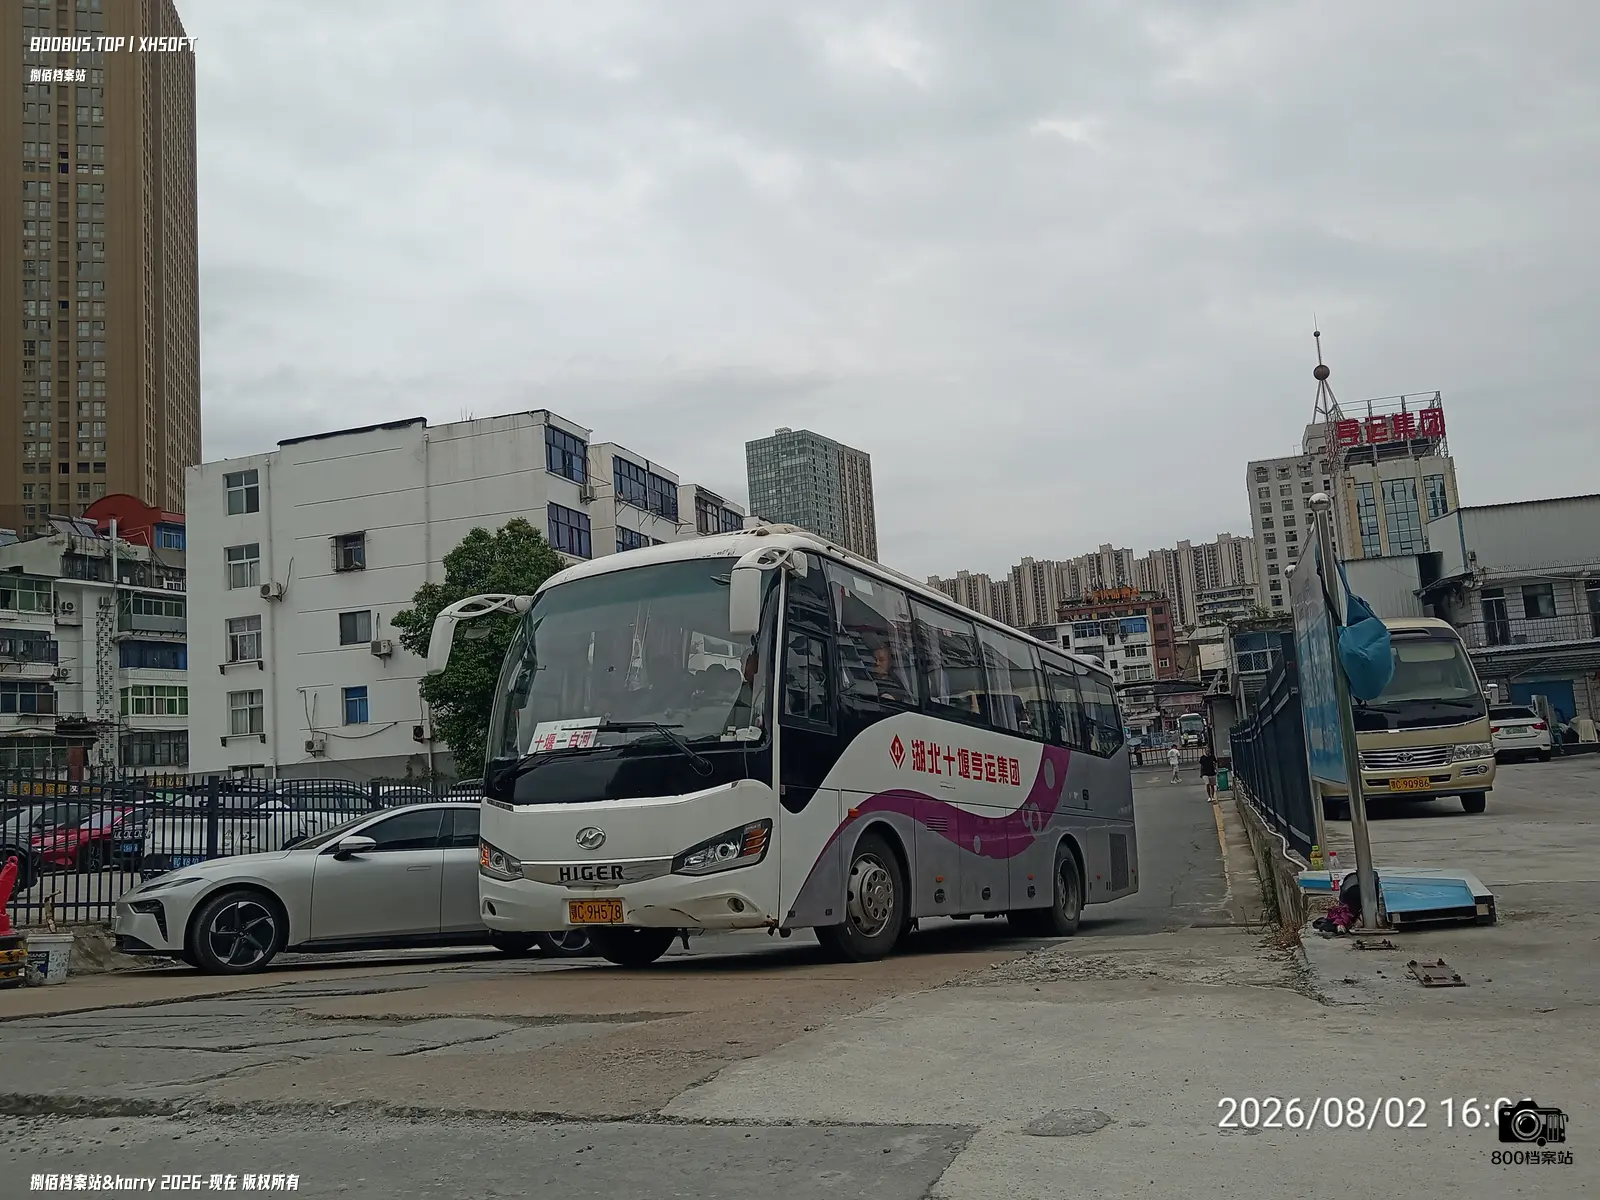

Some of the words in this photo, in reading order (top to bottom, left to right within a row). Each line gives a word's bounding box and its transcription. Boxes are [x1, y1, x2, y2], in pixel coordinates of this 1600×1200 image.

[911, 739, 1021, 787] 湖北十堰亨运集团
[559, 865, 624, 881] HIGER
